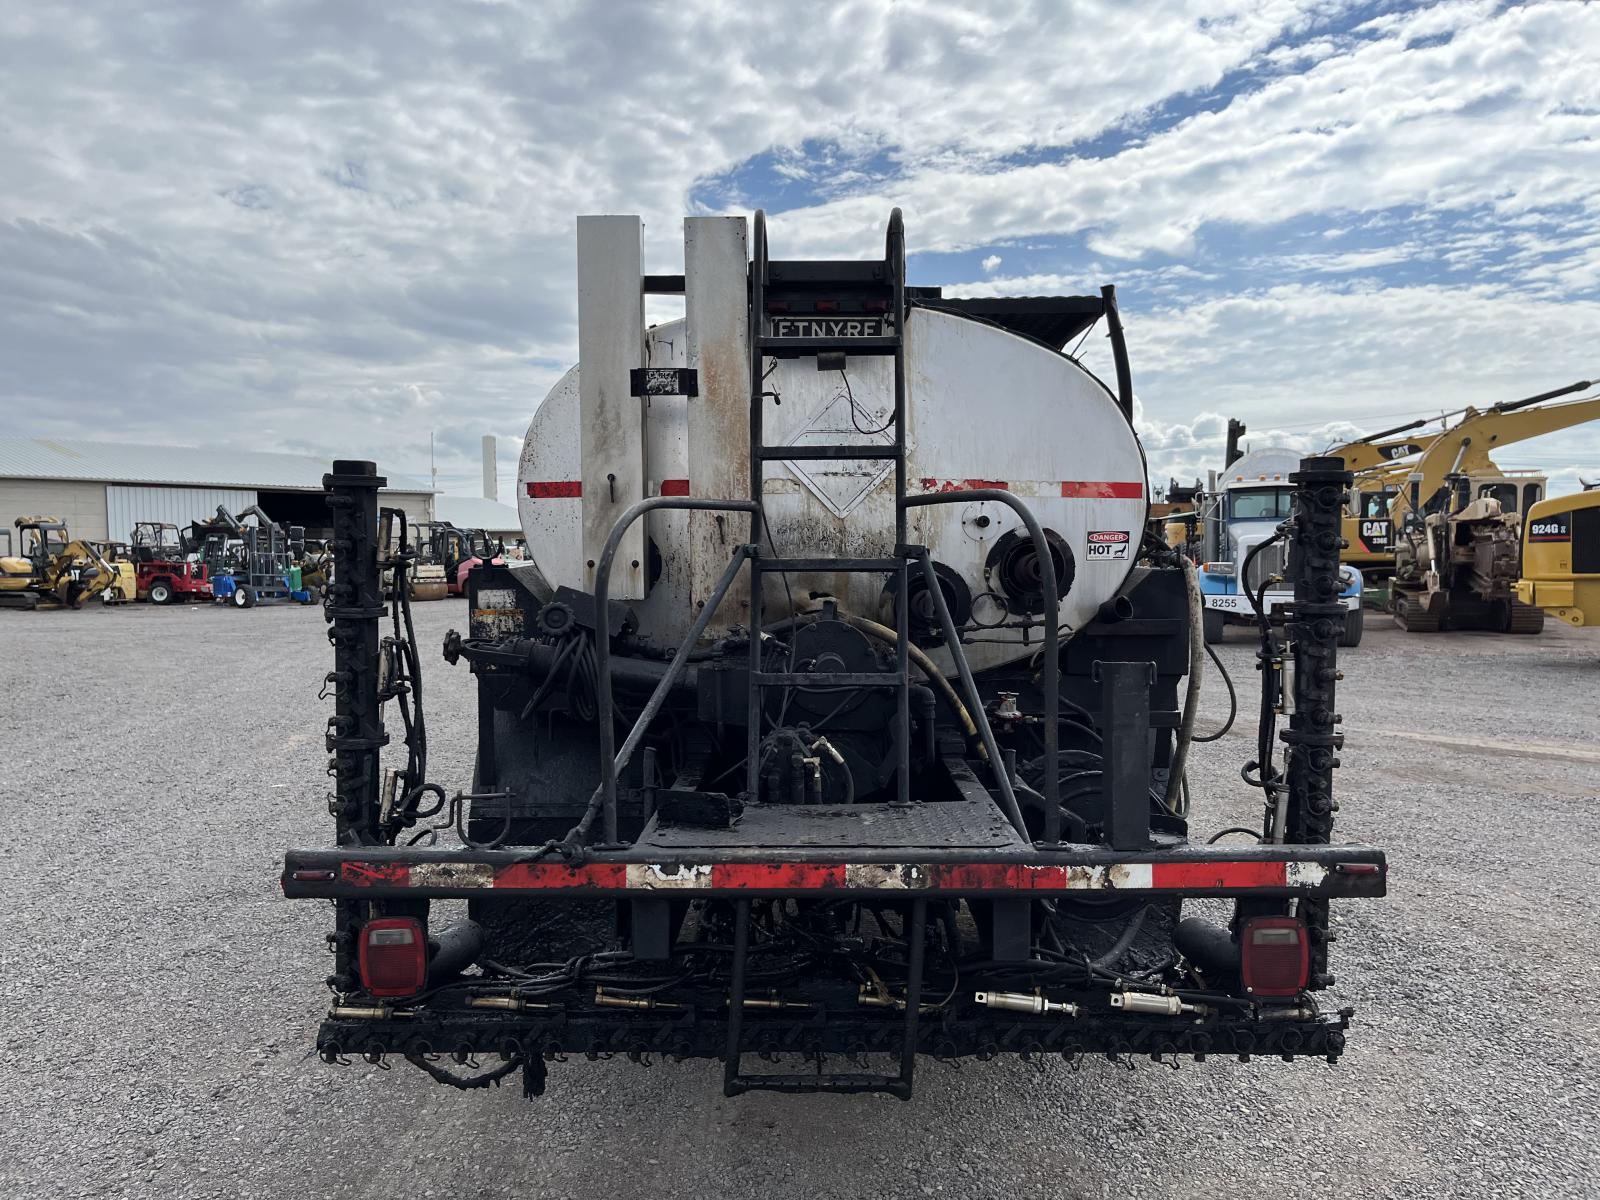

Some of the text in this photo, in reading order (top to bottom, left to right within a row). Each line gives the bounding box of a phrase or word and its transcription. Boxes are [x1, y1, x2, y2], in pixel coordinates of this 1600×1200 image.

[1391, 444, 1410, 459] CAT
[1362, 521, 1389, 537] CAT
[1532, 523, 1559, 535] 924G
[1088, 544, 1112, 555] HOT
[1211, 598, 1237, 608] 8255
